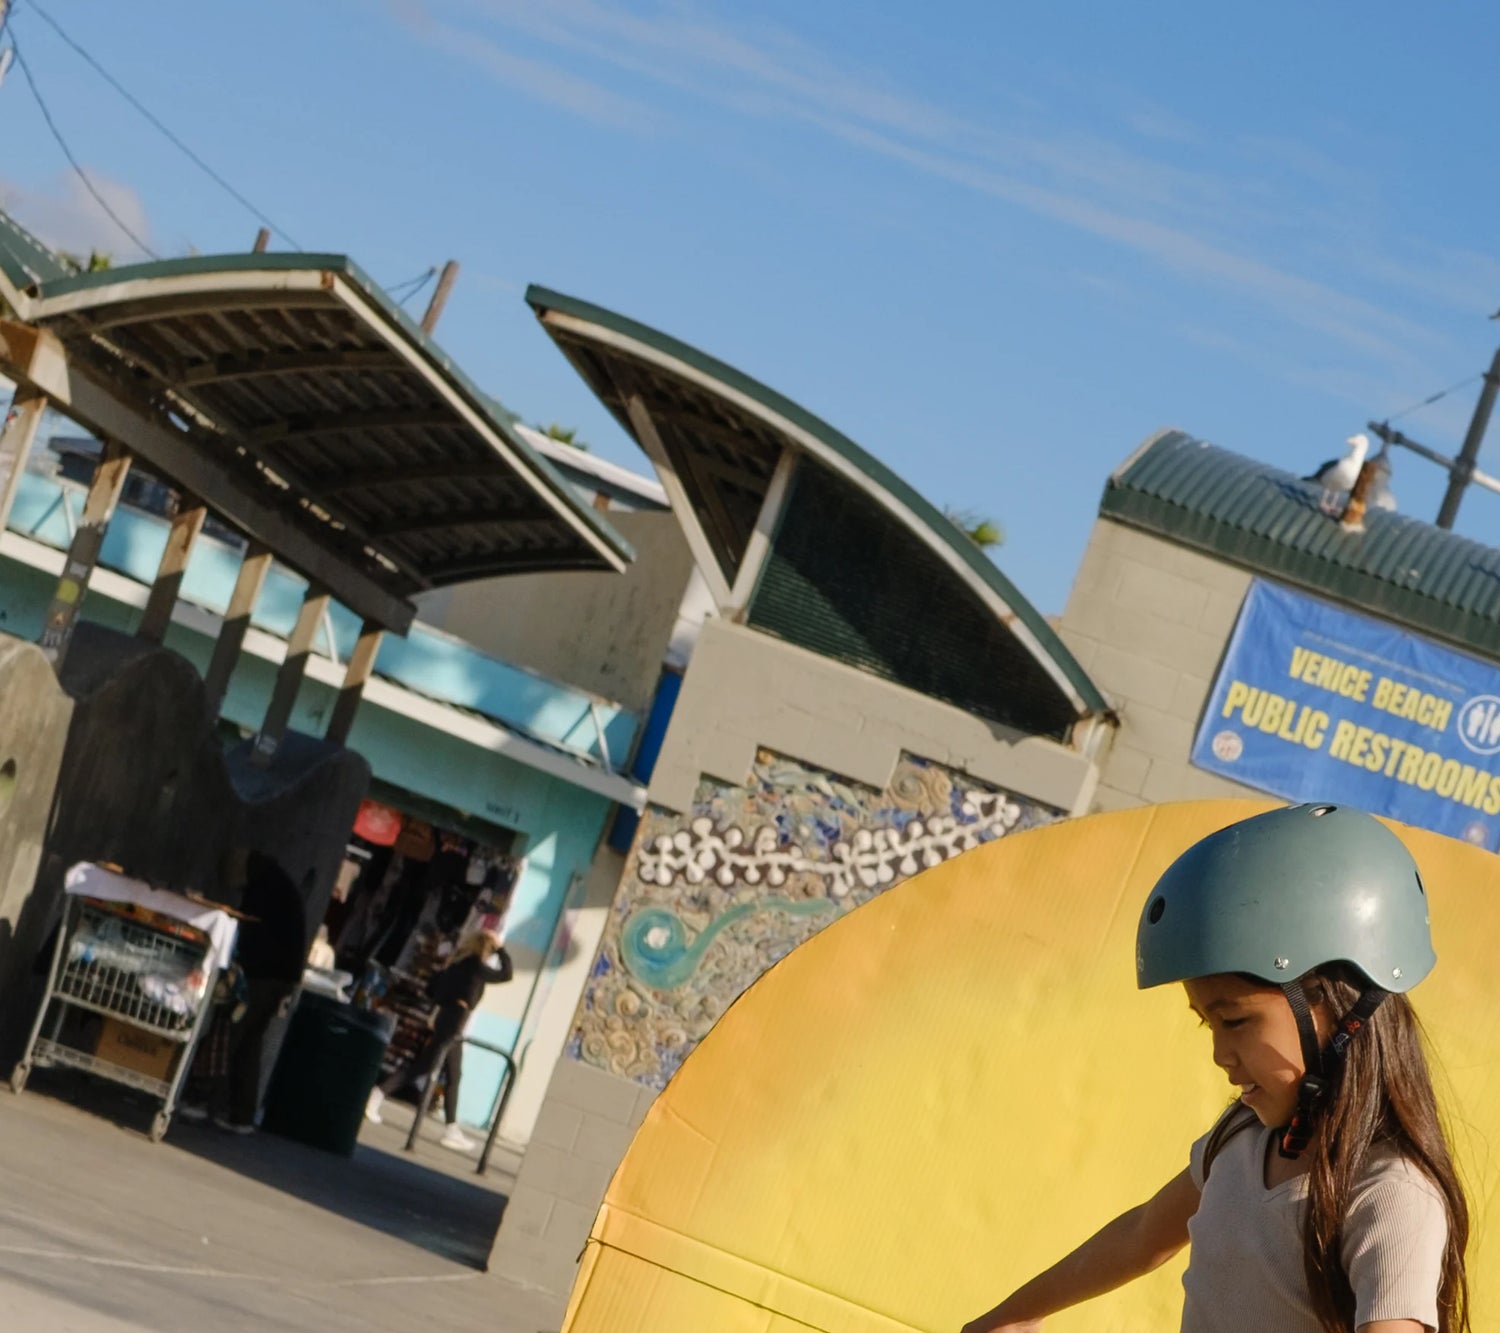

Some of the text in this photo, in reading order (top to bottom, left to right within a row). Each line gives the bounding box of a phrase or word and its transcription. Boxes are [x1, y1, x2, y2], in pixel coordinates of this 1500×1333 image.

[1221, 681, 1329, 750] PUBLIC
[1289, 647, 1373, 702] VENICE
[1372, 677, 1453, 732] BEACH
